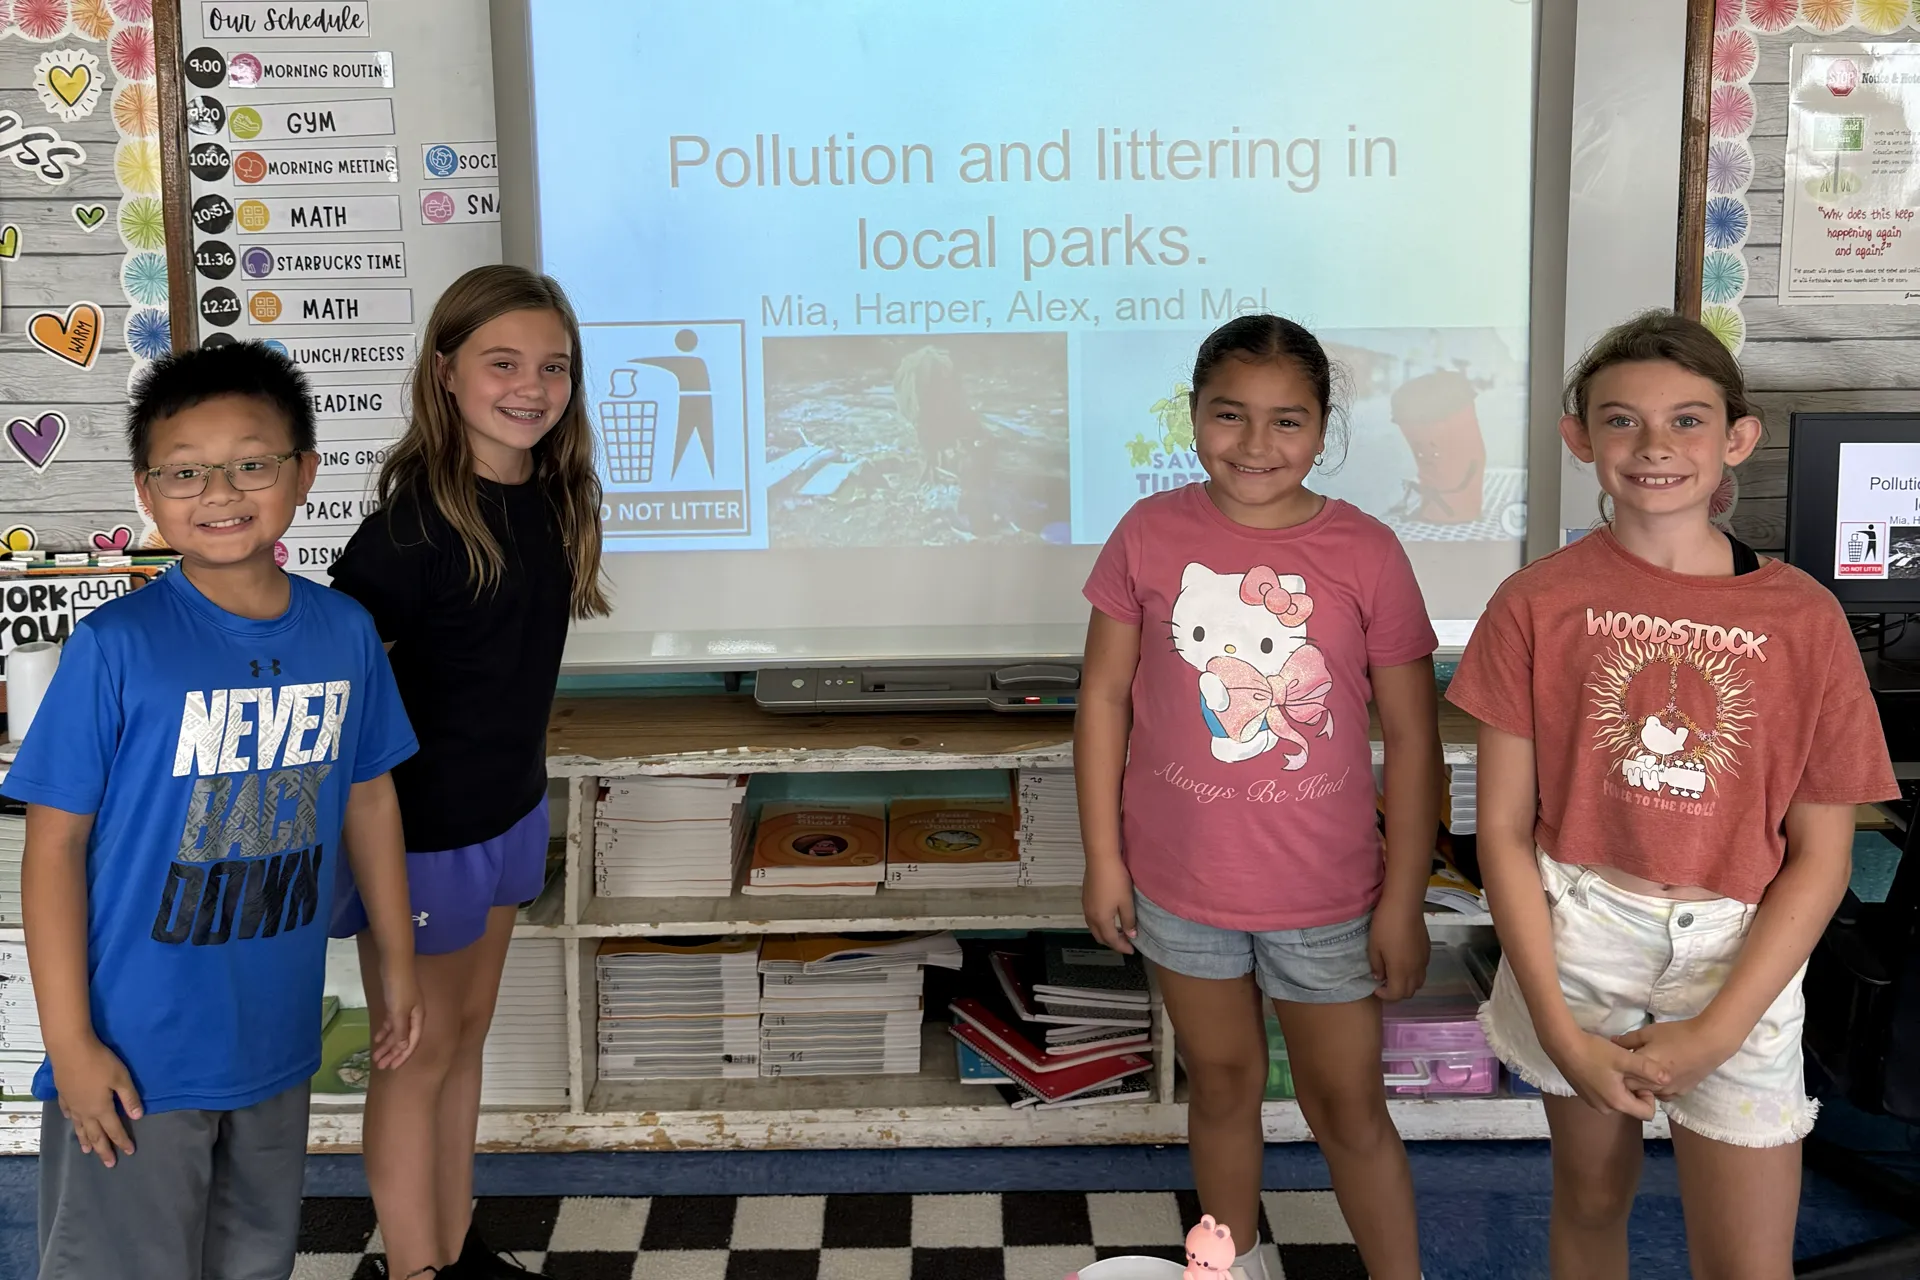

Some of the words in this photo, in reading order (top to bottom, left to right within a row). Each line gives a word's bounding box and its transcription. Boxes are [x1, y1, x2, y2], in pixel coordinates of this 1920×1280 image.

[209, 8, 256, 32] Our
[263, 5, 365, 31] Schedule
[189, 59, 222, 74] 9:00
[263, 64, 329, 79] MORNING
[333, 63, 389, 78] ROUTINE
[189, 106, 220, 122] 9:20
[287, 110, 337, 135] GYM
[190, 152, 230, 167] 10:06
[268, 160, 334, 176] MORNING
[338, 159, 395, 173] MEETING
[669, 131, 935, 188] Pollution
[958, 129, 1071, 184] and
[1097, 125, 1321, 193] littering
[1347, 124, 1397, 178] in
[193, 201, 231, 224] 10:51
[291, 205, 348, 228] MATH
[1847, 206, 1867, 220] does
[1870, 207, 1891, 220] this
[1895, 208, 1915, 222] keep
[1827, 226, 1872, 241] happening
[1876, 225, 1902, 241] again
[858, 215, 996, 271] local
[1022, 213, 1207, 282] parks.
[1835, 243, 1852, 256] and
[196, 252, 234, 266] 11:36
[277, 254, 362, 272] STARBUCKS
[367, 254, 402, 270] TIME
[202, 298, 239, 314] 12:21
[303, 297, 359, 320] MATH
[761, 294, 839, 331] Mia,
[855, 292, 993, 332] Harper,
[1006, 289, 1100, 327] Alex,
[1115, 288, 1185, 321] and
[68, 319, 94, 355] WARM
[293, 346, 405, 364] LUNCH/RECESS
[314, 393, 383, 413] EADING
[307, 501, 352, 520] PACK
[619, 502, 665, 521] NOT
[671, 501, 740, 520] LITTER
[1586, 607, 1769, 663] WOODSTOCK
[172, 680, 351, 777] NEVER
[1154, 761, 1240, 804] Always
[1246, 779, 1290, 804] Be
[1295, 766, 1351, 802] Kind
[1634, 792, 1651, 807] TO
[1653, 797, 1677, 812] THE
[176, 764, 333, 862] BACK
[756, 868, 766, 879] 13
[891, 871, 902, 881] 13
[151, 842, 323, 946] DOWN
